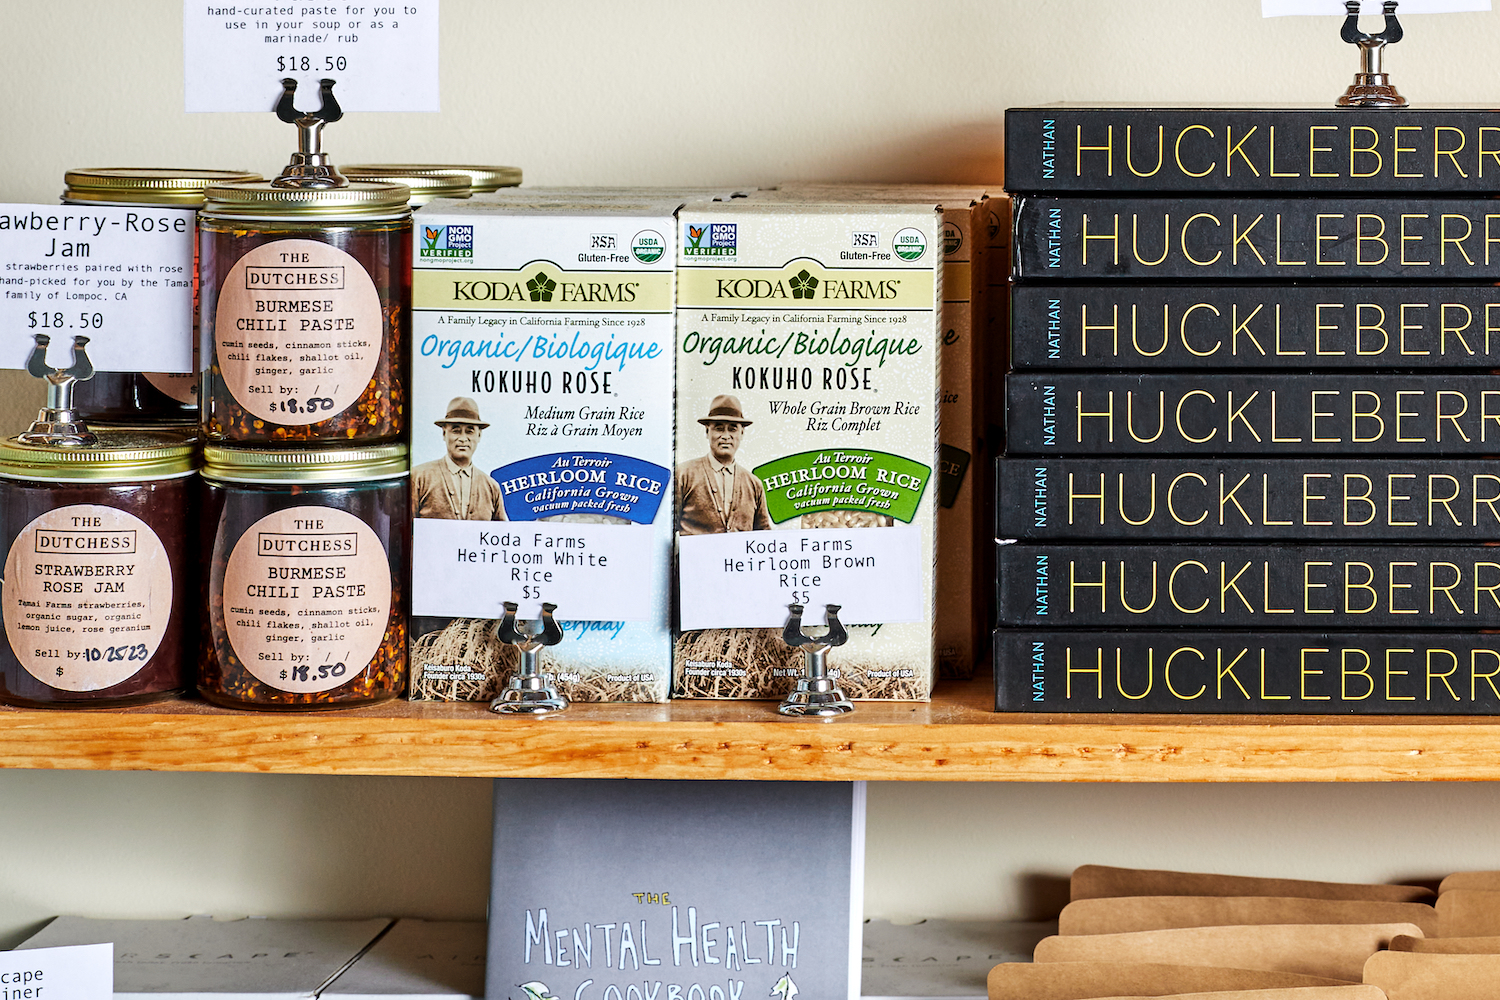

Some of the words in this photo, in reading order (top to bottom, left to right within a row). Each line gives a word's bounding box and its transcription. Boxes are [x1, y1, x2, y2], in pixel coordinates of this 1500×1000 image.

[207, 5, 295, 16] hand-curated
[300, 6, 338, 17] paste
[345, 5, 366, 16] for
[373, 6, 396, 17] you
[403, 6, 418, 15] to
[224, 20, 247, 30] use
[255, 19, 269, 30] in
[275, 20, 304, 32] your
[312, 20, 341, 31] soup
[348, 20, 362, 29] or
[369, 20, 385, 29] as
[391, 20, 399, 29] a
[264, 32, 330, 44] marinade/
[337, 33, 359, 44] rub
[276, 55, 348, 73] $18.50
[1042, 118, 1057, 180] NATHAN
[44, 237, 91, 258] Jam
[279, 252, 310, 264] THE
[577, 252, 630, 264] Gluten-Free
[5, 262, 80, 273] strawberries
[84, 263, 123, 274] paired
[127, 263, 153, 274] with
[159, 264, 184, 274] rose
[250, 272, 340, 286] DUTCHESS
[5, 290, 42, 302] family
[47, 291, 60, 300] of
[114, 292, 128, 302] CA
[452, 280, 527, 302] KODA
[559, 281, 637, 303] FARMS
[255, 300, 334, 313] BURMESE
[27, 310, 104, 330] $18.50
[236, 318, 287, 332] CHILI
[299, 317, 355, 332] PASTE
[221, 340, 244, 349] cumin
[247, 341, 279, 350] seeds,
[285, 341, 332, 349] cinnamon
[336, 340, 372, 348] sticks,
[420, 330, 664, 373] Organic/Biologique
[471, 369, 551, 394] KOKUHO
[562, 370, 613, 395] ROSE
[524, 405, 575, 422] Medium
[578, 405, 616, 422] Grain
[618, 406, 646, 422] Rice
[71, 516, 102, 527] THE
[39, 536, 131, 549] DUTCHESS
[479, 531, 522, 548] Koda
[533, 533, 587, 549] Farms
[745, 539, 788, 554] Koda
[800, 537, 854, 552] Farms
[457, 547, 543, 565] Heirloom
[553, 551, 608, 568] White
[723, 556, 811, 573] Heirloom
[822, 554, 876, 570] Brown
[34, 563, 136, 577] STRAWBERRY
[510, 567, 553, 583] Rice
[42, 581, 83, 593] ROSE
[94, 581, 126, 593] JAM
[779, 573, 822, 588] Rice
[522, 584, 542, 601] $5
[791, 590, 811, 605] $5
[631, 891, 672, 906] THE
[523, 906, 662, 971] MENTAL
[670, 904, 801, 972] HEALTH
